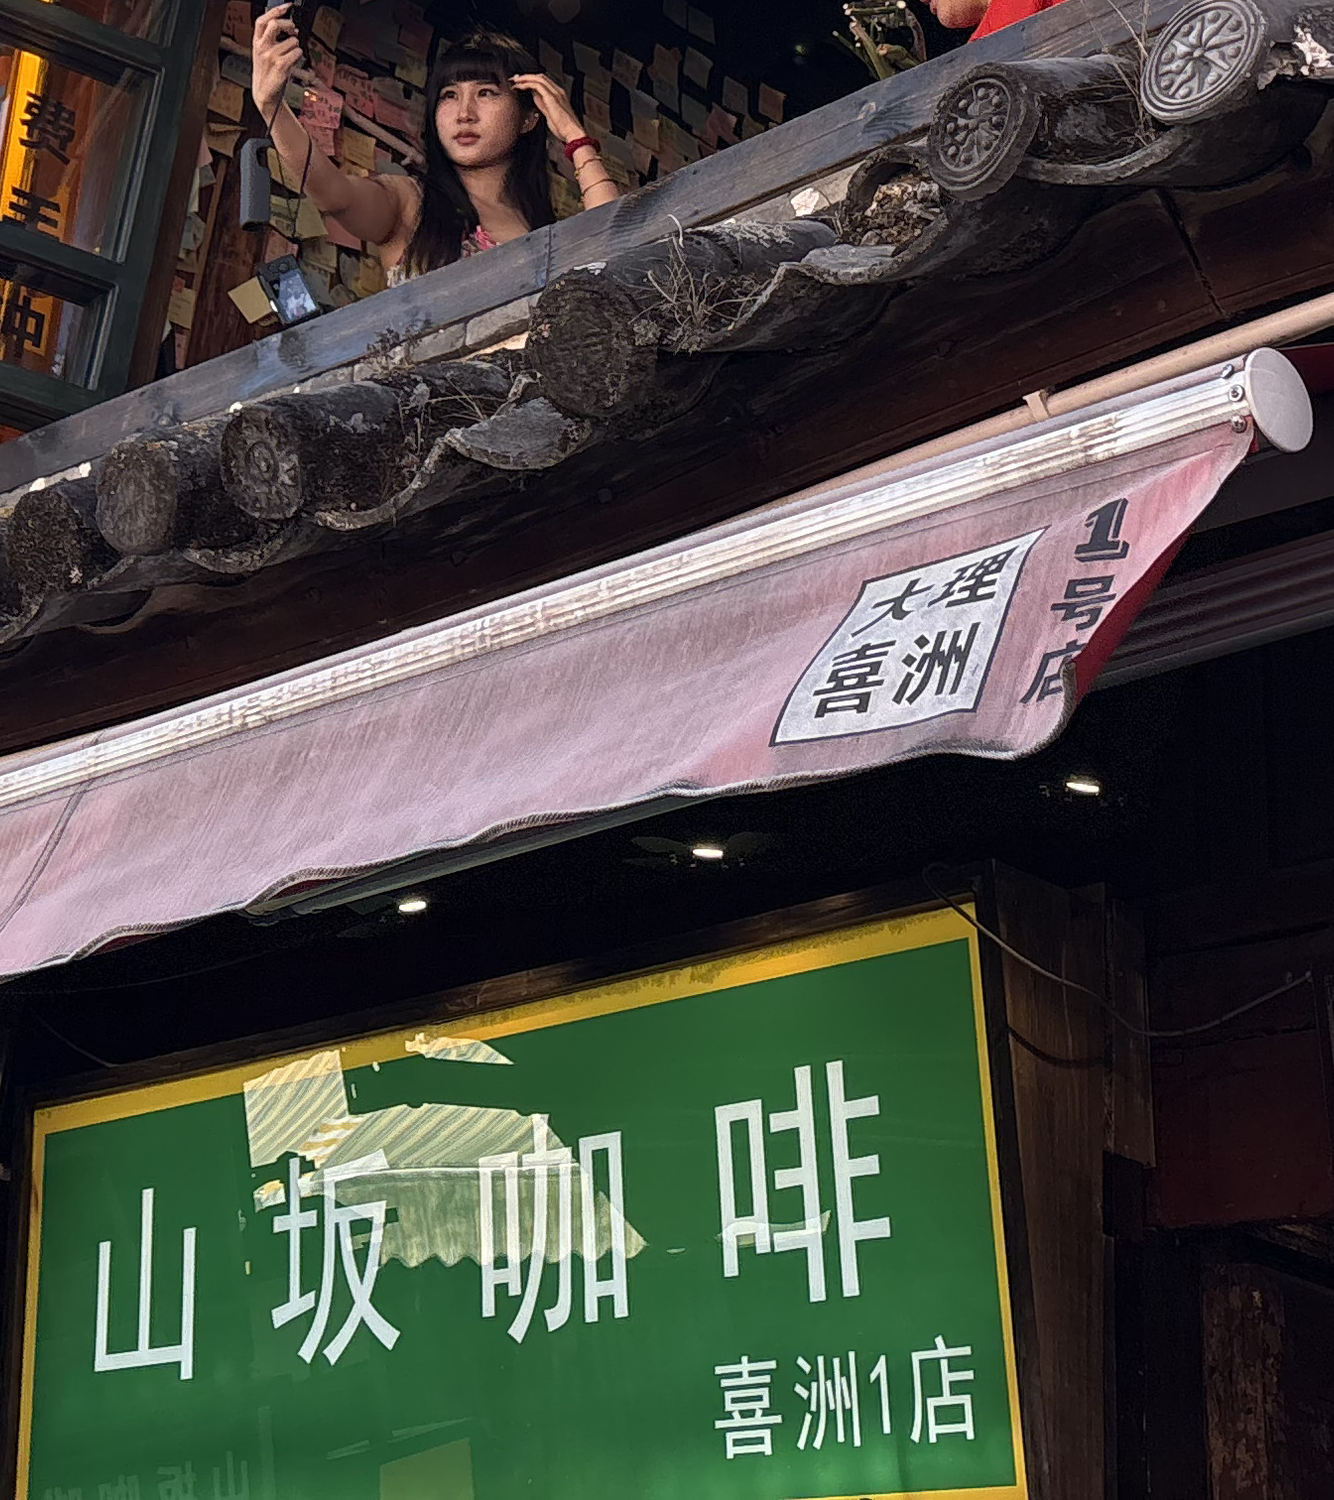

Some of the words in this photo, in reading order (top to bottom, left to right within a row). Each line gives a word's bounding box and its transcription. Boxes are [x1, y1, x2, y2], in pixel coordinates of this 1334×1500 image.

[851, 546, 1022, 638] 大理
[812, 622, 981, 720] 喜洲
[93, 1060, 891, 1379] 山坂咖啡
[714, 1335, 975, 1459] 喜洲1店
